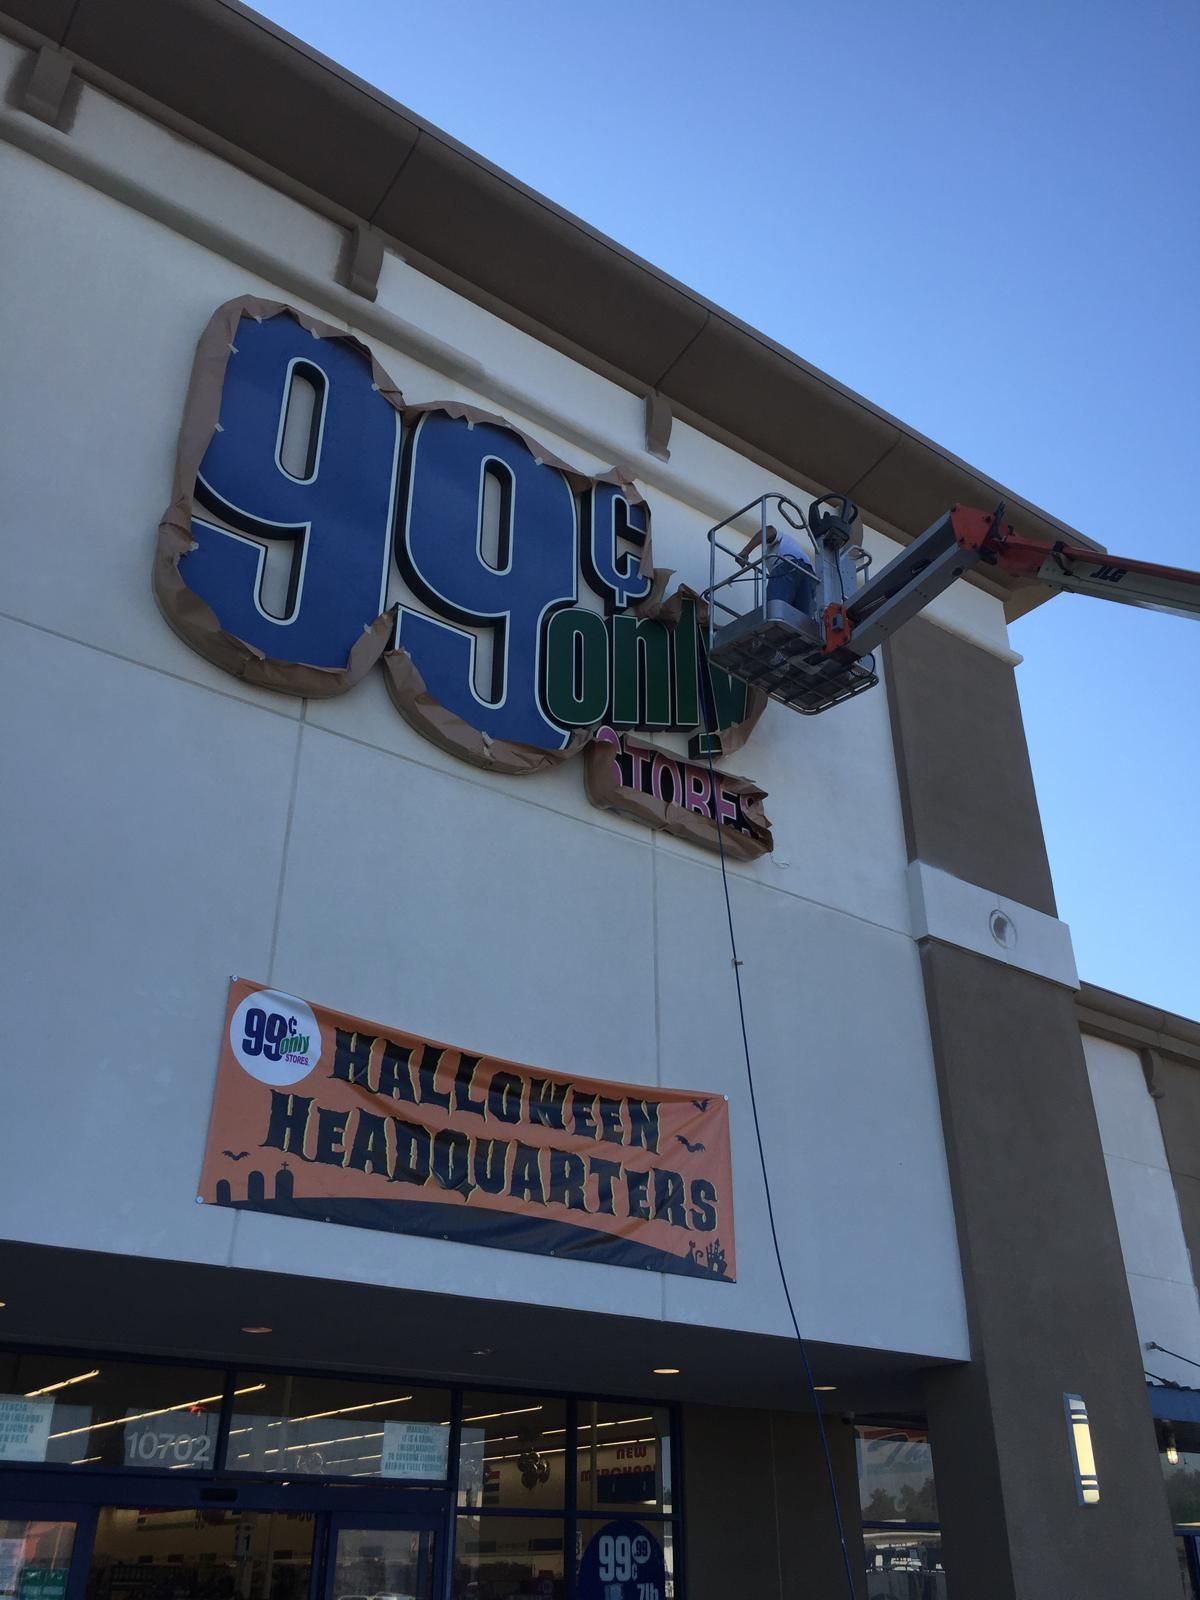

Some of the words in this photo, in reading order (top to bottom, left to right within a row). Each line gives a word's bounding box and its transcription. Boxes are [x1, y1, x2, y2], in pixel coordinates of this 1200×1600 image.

[1089, 564, 1127, 583] JLG
[279, 1033, 310, 1056] only
[284, 1053, 310, 1066] STORES
[327, 1027, 662, 1155] HALLOWEEN
[258, 1088, 719, 1233] HEADQUARTERS
[126, 1431, 212, 1463] 10702
